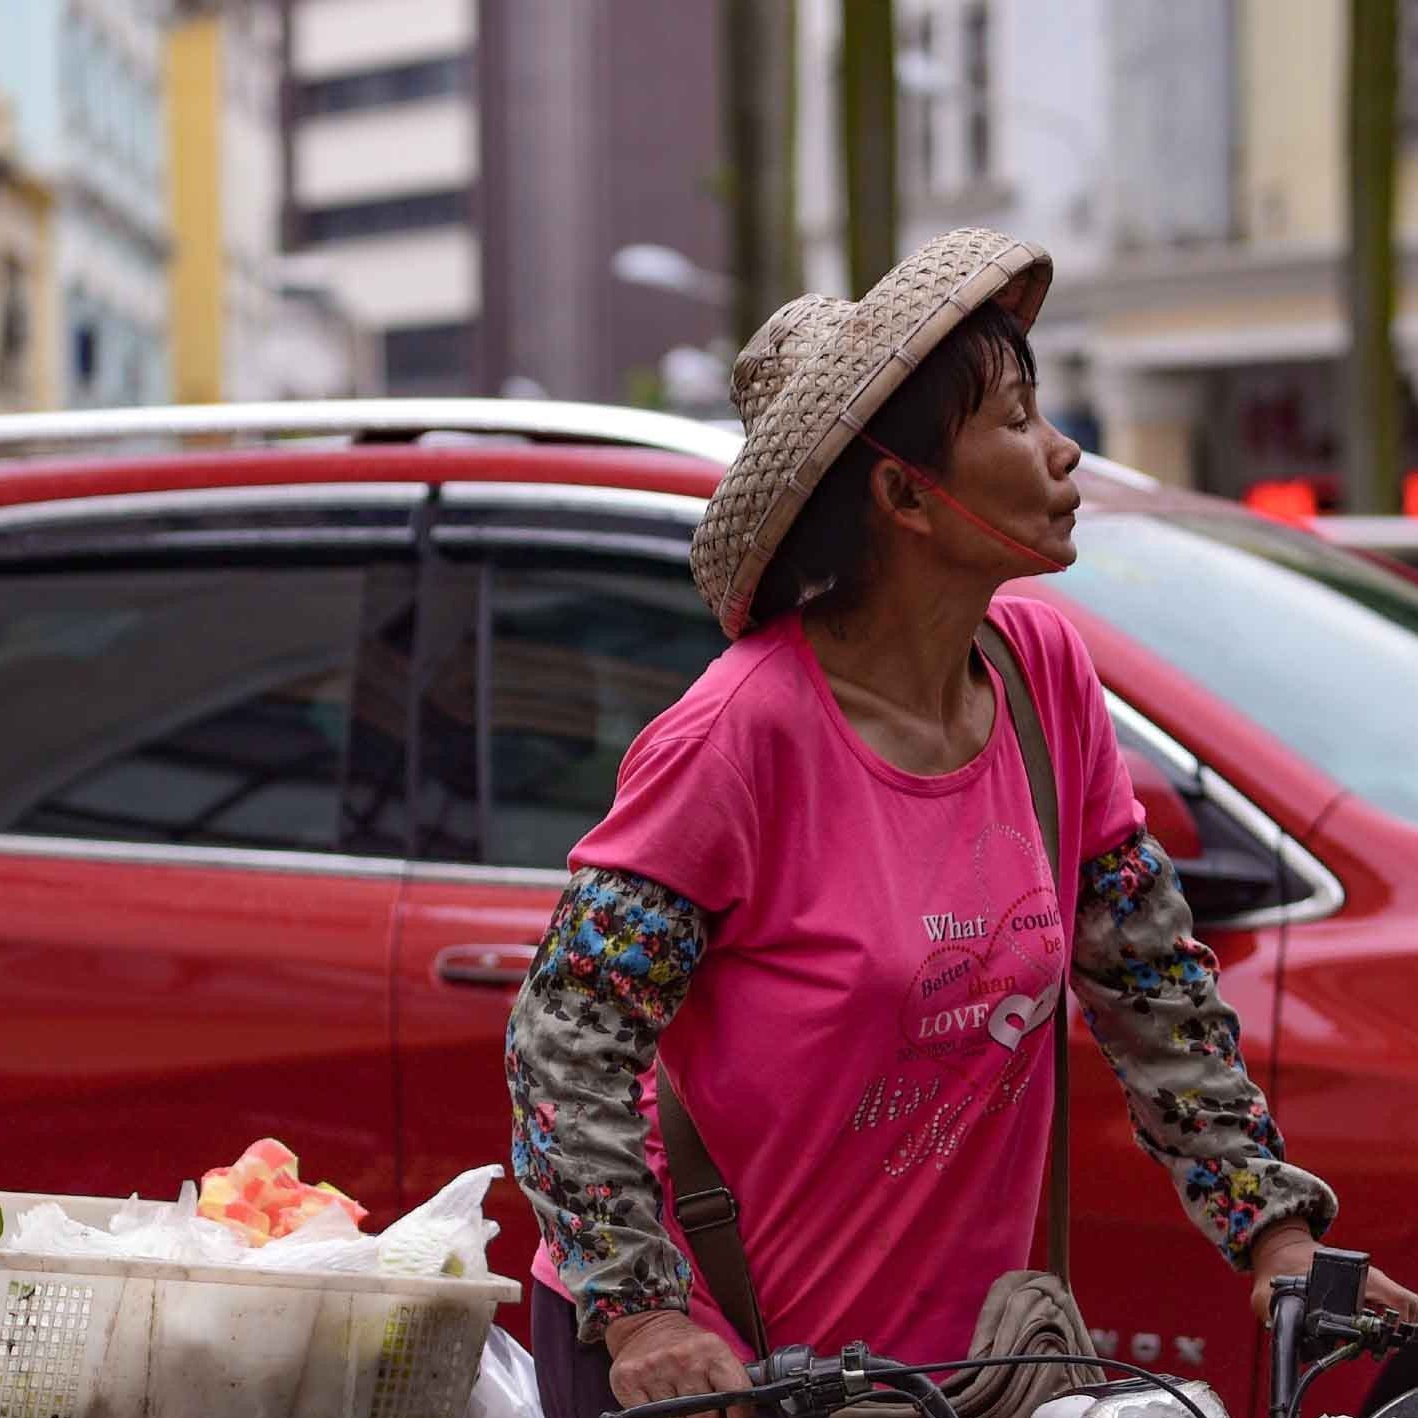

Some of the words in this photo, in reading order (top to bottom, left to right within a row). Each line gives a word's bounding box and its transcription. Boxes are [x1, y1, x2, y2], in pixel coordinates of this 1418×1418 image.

[922, 911, 989, 942] What
[1040, 934, 1062, 955] be
[968, 975, 1016, 997] than
